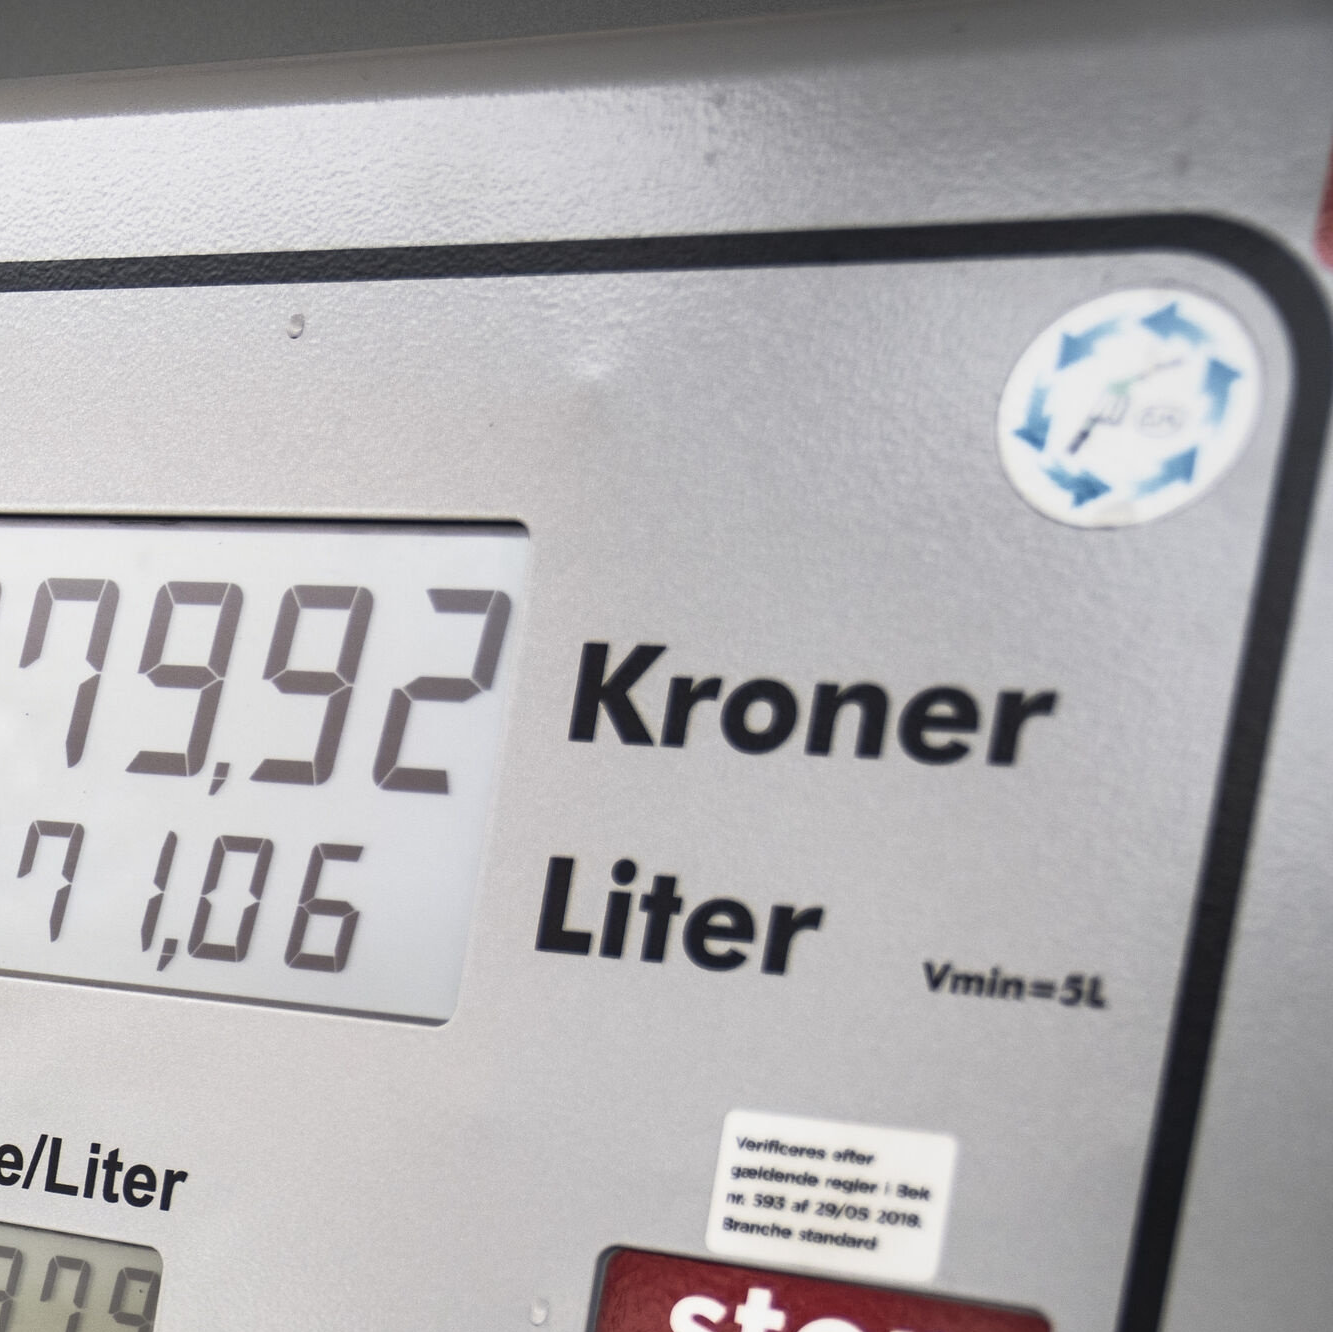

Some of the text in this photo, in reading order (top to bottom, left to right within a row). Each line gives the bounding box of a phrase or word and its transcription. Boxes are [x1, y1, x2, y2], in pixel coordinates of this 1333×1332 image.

[568, 641, 1059, 768] Kroner
[535, 856, 824, 975] Liter
[923, 959, 1109, 1010] Vmin=5L
[736, 1136, 875, 1166] Verificeres efter
[730, 1165, 819, 1187] gældende
[825, 1176, 878, 1195] regler
[790, 1199, 809, 1213] af
[722, 1217, 879, 1251] Branche standard
